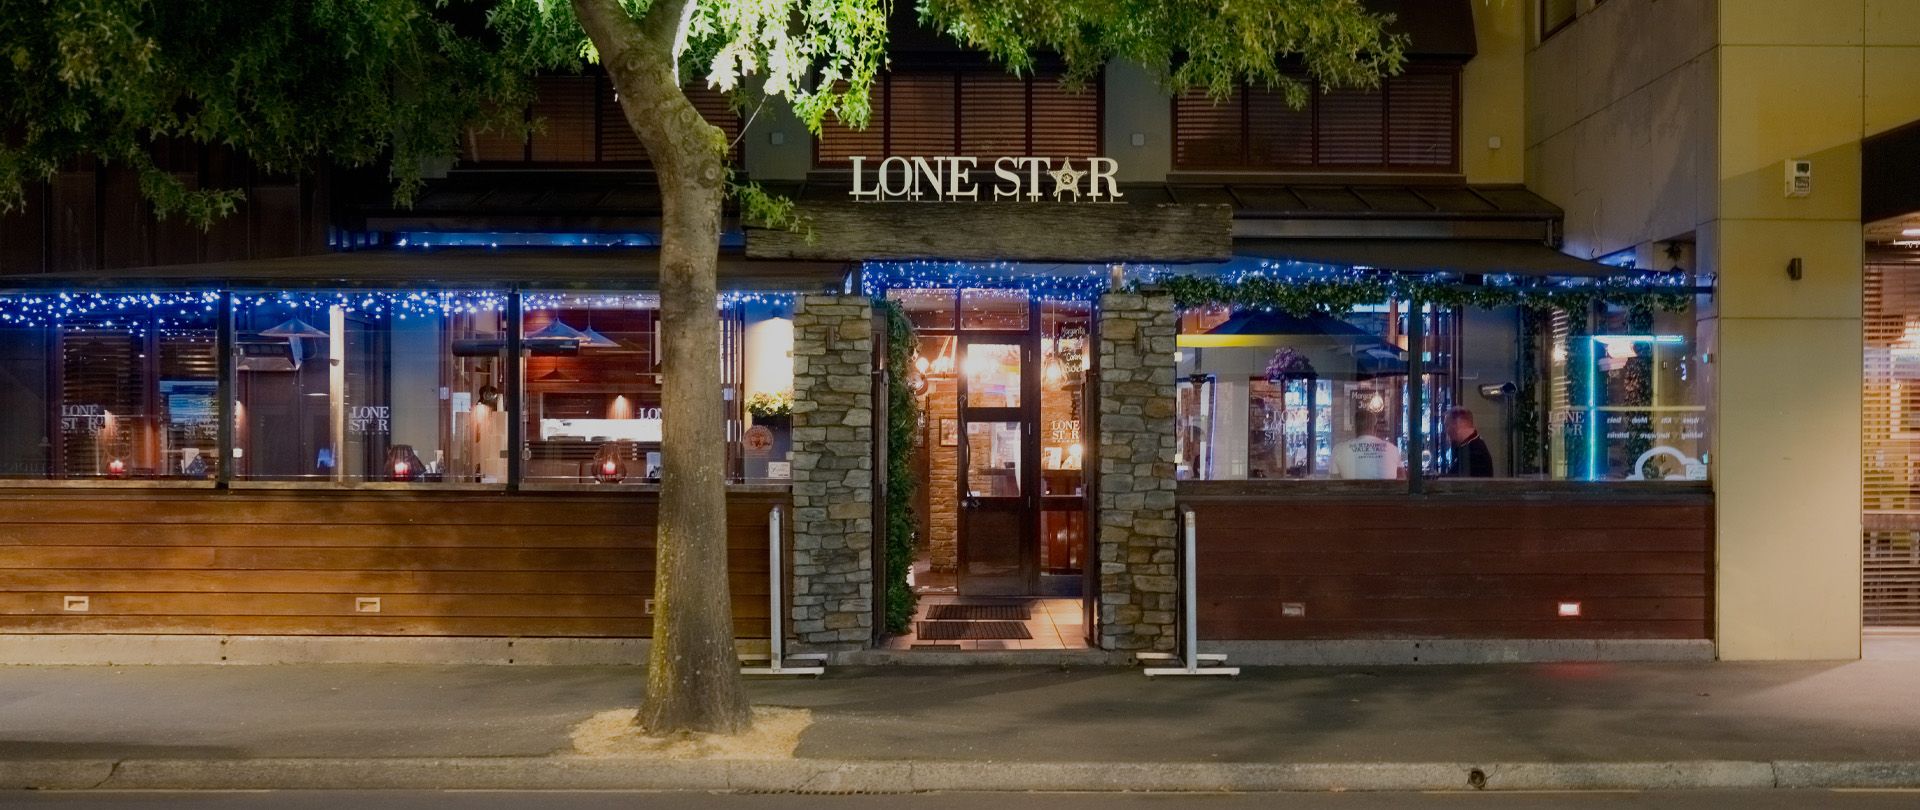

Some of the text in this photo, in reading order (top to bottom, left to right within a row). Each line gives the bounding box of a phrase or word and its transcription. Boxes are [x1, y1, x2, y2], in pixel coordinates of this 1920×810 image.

[848, 156, 978, 197] LONE
[61, 403, 98, 417] LONE
[352, 406, 390, 418] LONE
[1052, 420, 1080, 431] LONE
